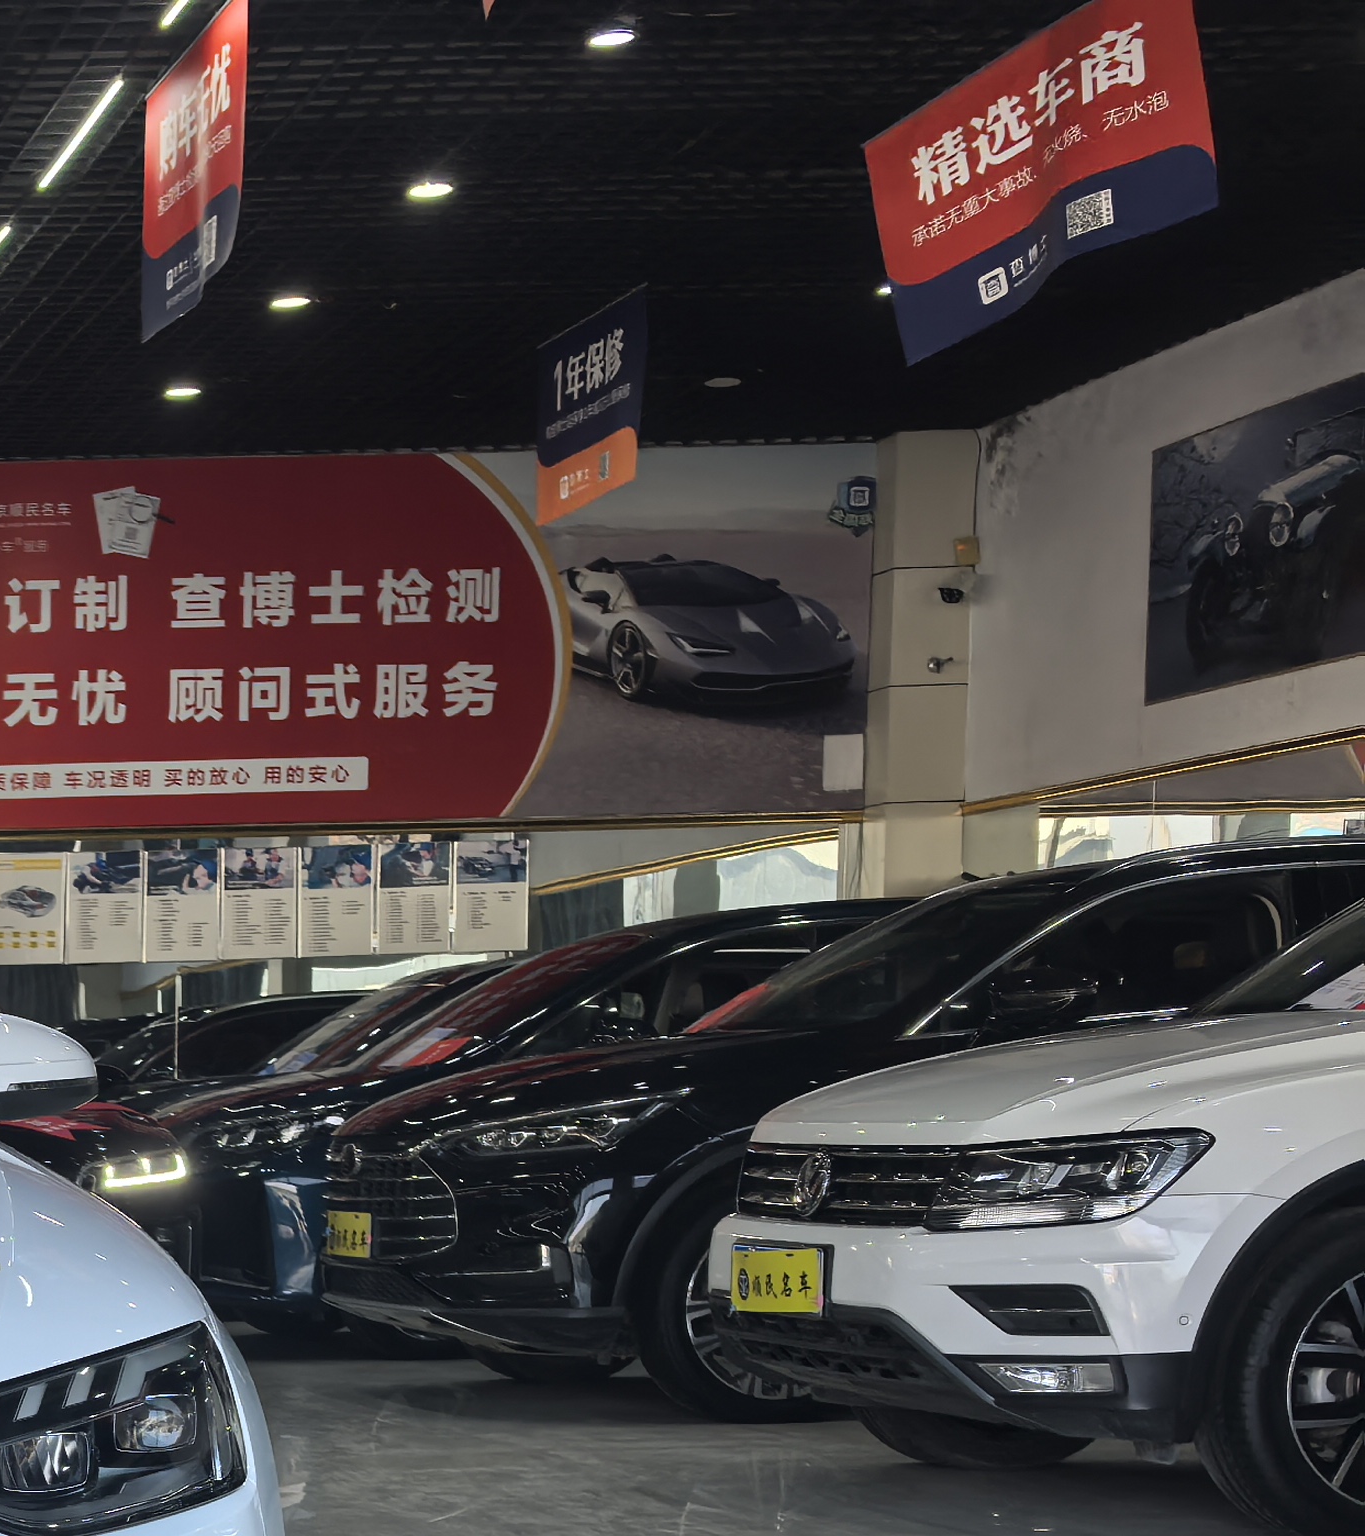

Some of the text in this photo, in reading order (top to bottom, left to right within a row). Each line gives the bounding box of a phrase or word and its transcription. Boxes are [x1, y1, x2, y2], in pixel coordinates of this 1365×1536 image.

[911, 22, 1145, 204] 精选车商
[554, 328, 624, 411] 1年保修
[169, 567, 501, 628] 查博士检测
[168, 661, 498, 723] 顾问式服务
[64, 769, 152, 790] 车况透明
[164, 767, 251, 787] 买的放心
[263, 764, 350, 785] 用的安心
[751, 1270, 813, 1299] 顺民名车
